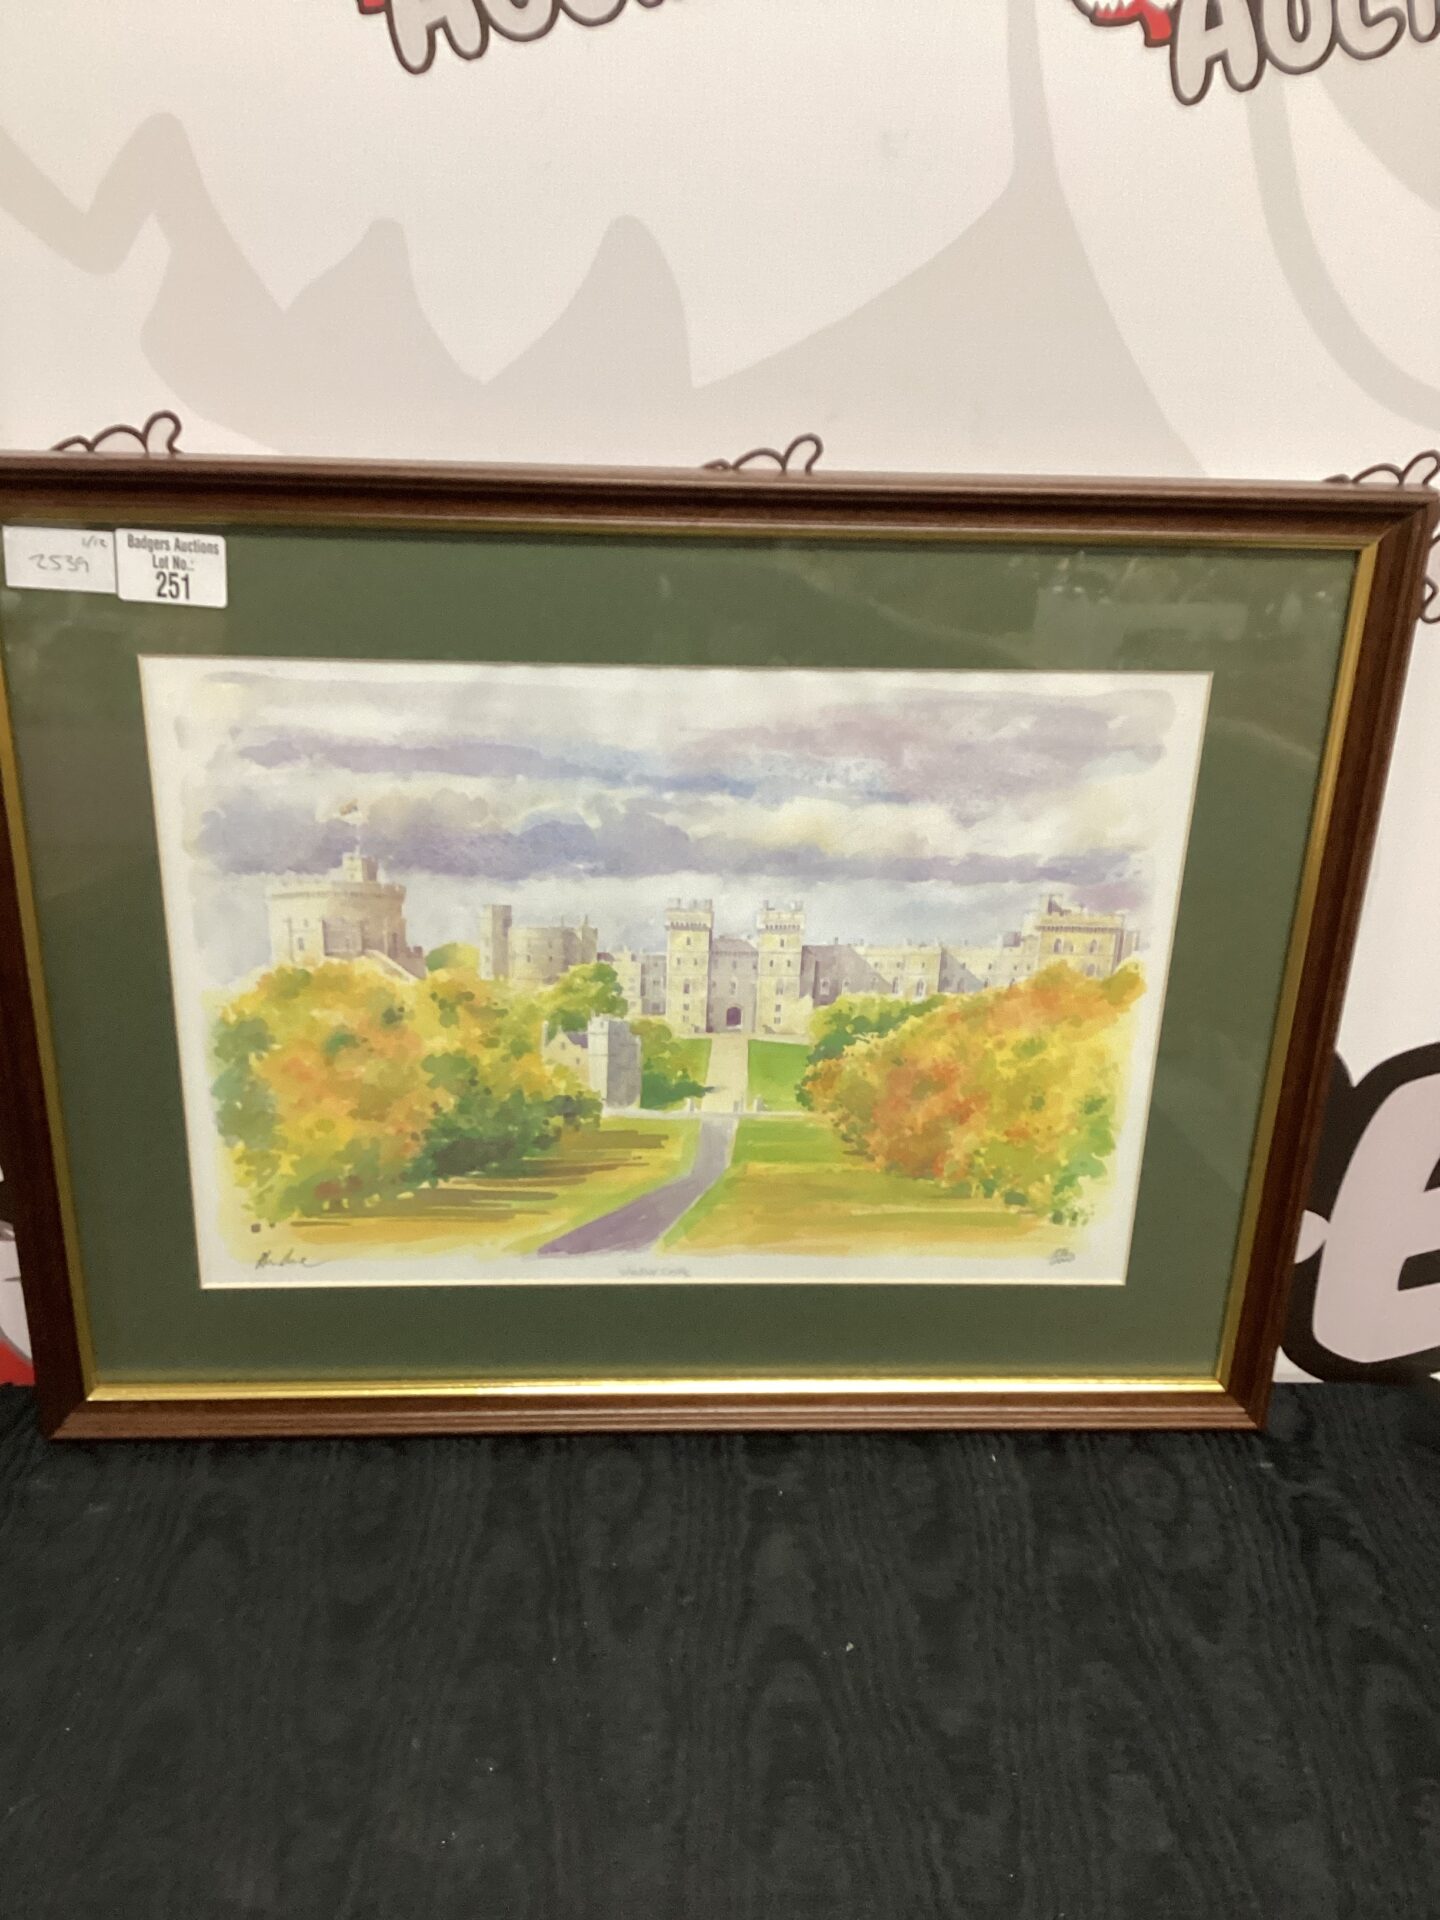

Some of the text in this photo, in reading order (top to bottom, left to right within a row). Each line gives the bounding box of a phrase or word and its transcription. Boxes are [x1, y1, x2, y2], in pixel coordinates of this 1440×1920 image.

[127, 533, 220, 556] Badgers Auctions
[28, 553, 90, 573] 2539
[152, 554, 169, 570] Lot
[156, 570, 190, 600] 251
